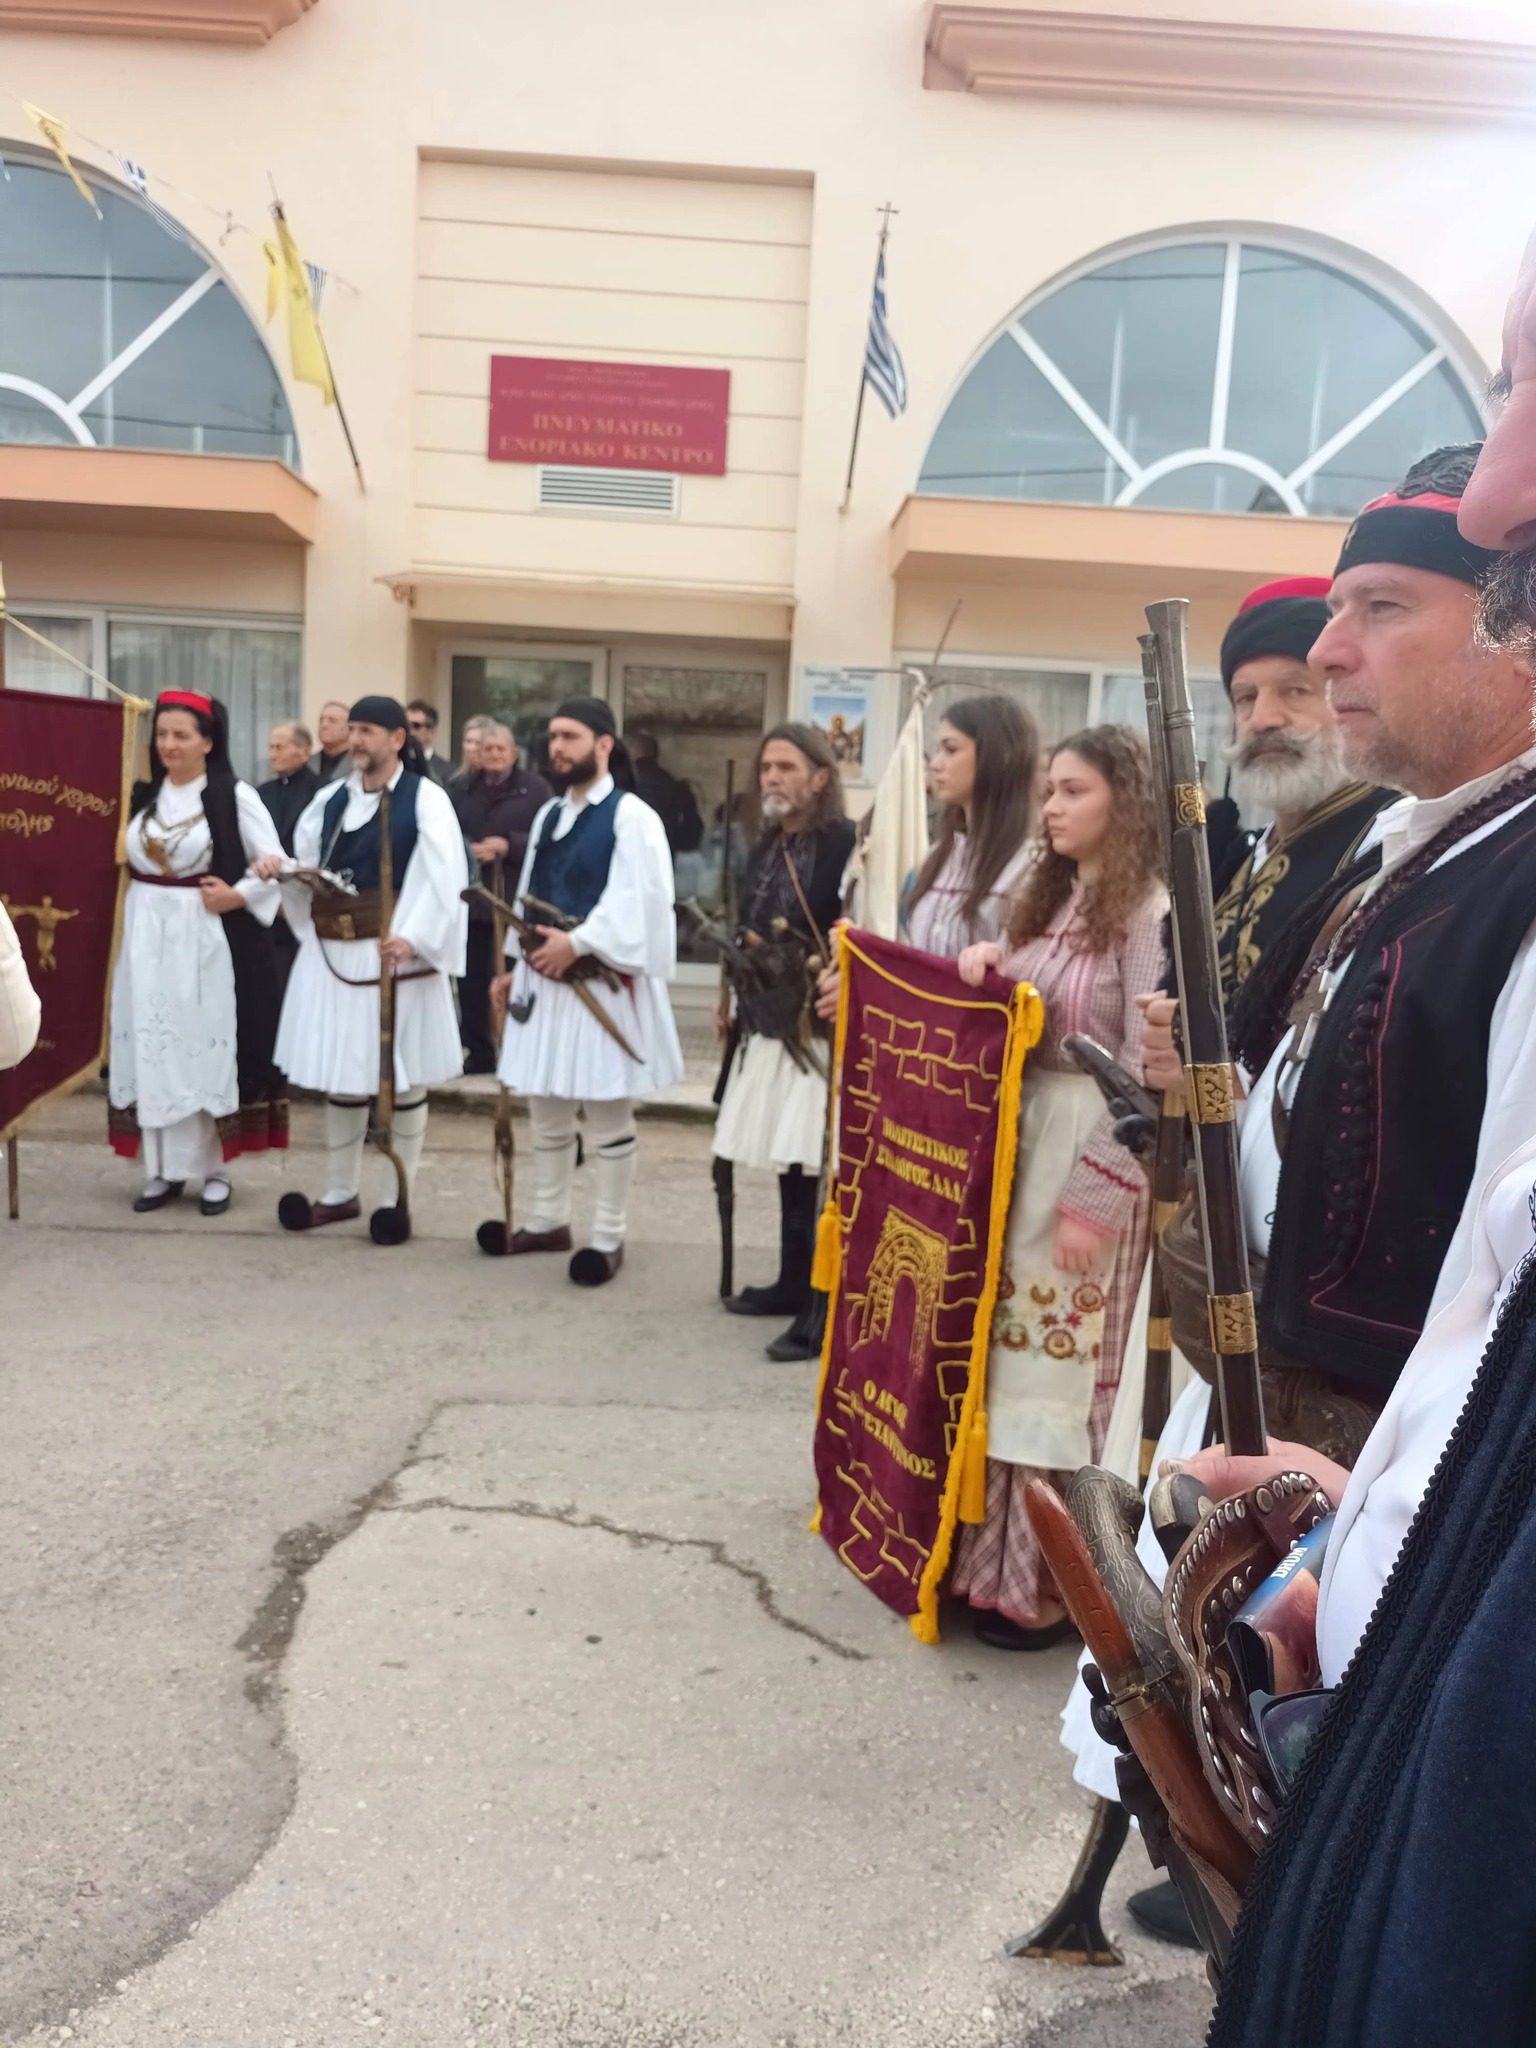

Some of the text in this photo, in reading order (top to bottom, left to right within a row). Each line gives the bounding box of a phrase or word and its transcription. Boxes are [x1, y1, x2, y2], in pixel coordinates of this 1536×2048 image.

[531, 412, 684, 438] ΠΝΕΥΜΑΤΙΚΟ
[498, 434, 714, 466] ΕΝΟΡΙΑΚΟ ΚΕΝΤΡΟ
[1269, 1547, 1309, 1579] DRUM
